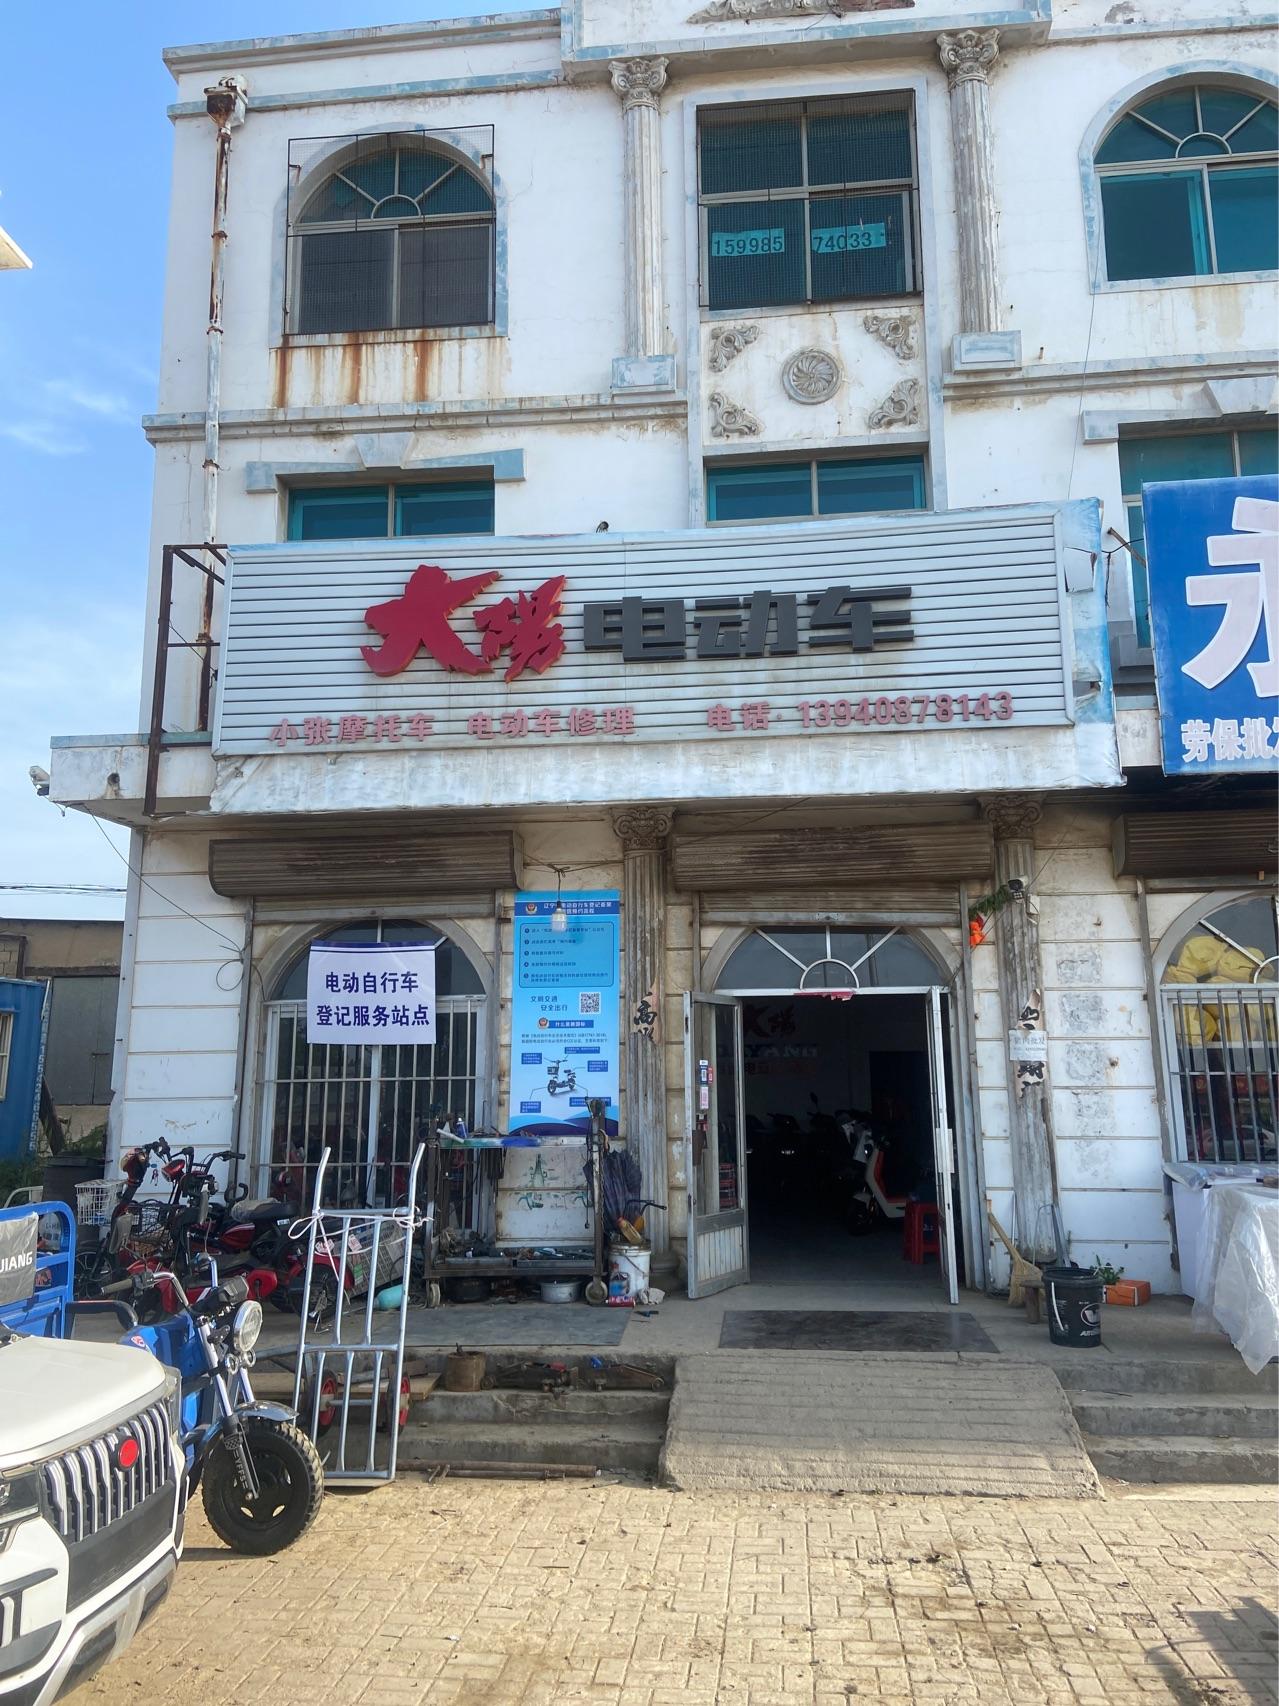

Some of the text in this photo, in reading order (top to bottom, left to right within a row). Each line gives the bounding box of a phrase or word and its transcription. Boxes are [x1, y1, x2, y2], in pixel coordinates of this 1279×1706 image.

[713, 232, 872, 255] 159985 74033
[583, 585, 915, 662] 电动车
[269, 712, 435, 747] 小张摩托车
[466, 706, 636, 740] 电动车修理
[798, 691, 1013, 728] 13940878143
[1181, 717, 1279, 763] 劳保批
[325, 971, 419, 994] 电动自行车
[316, 1004, 430, 1027] 登记服务站点
